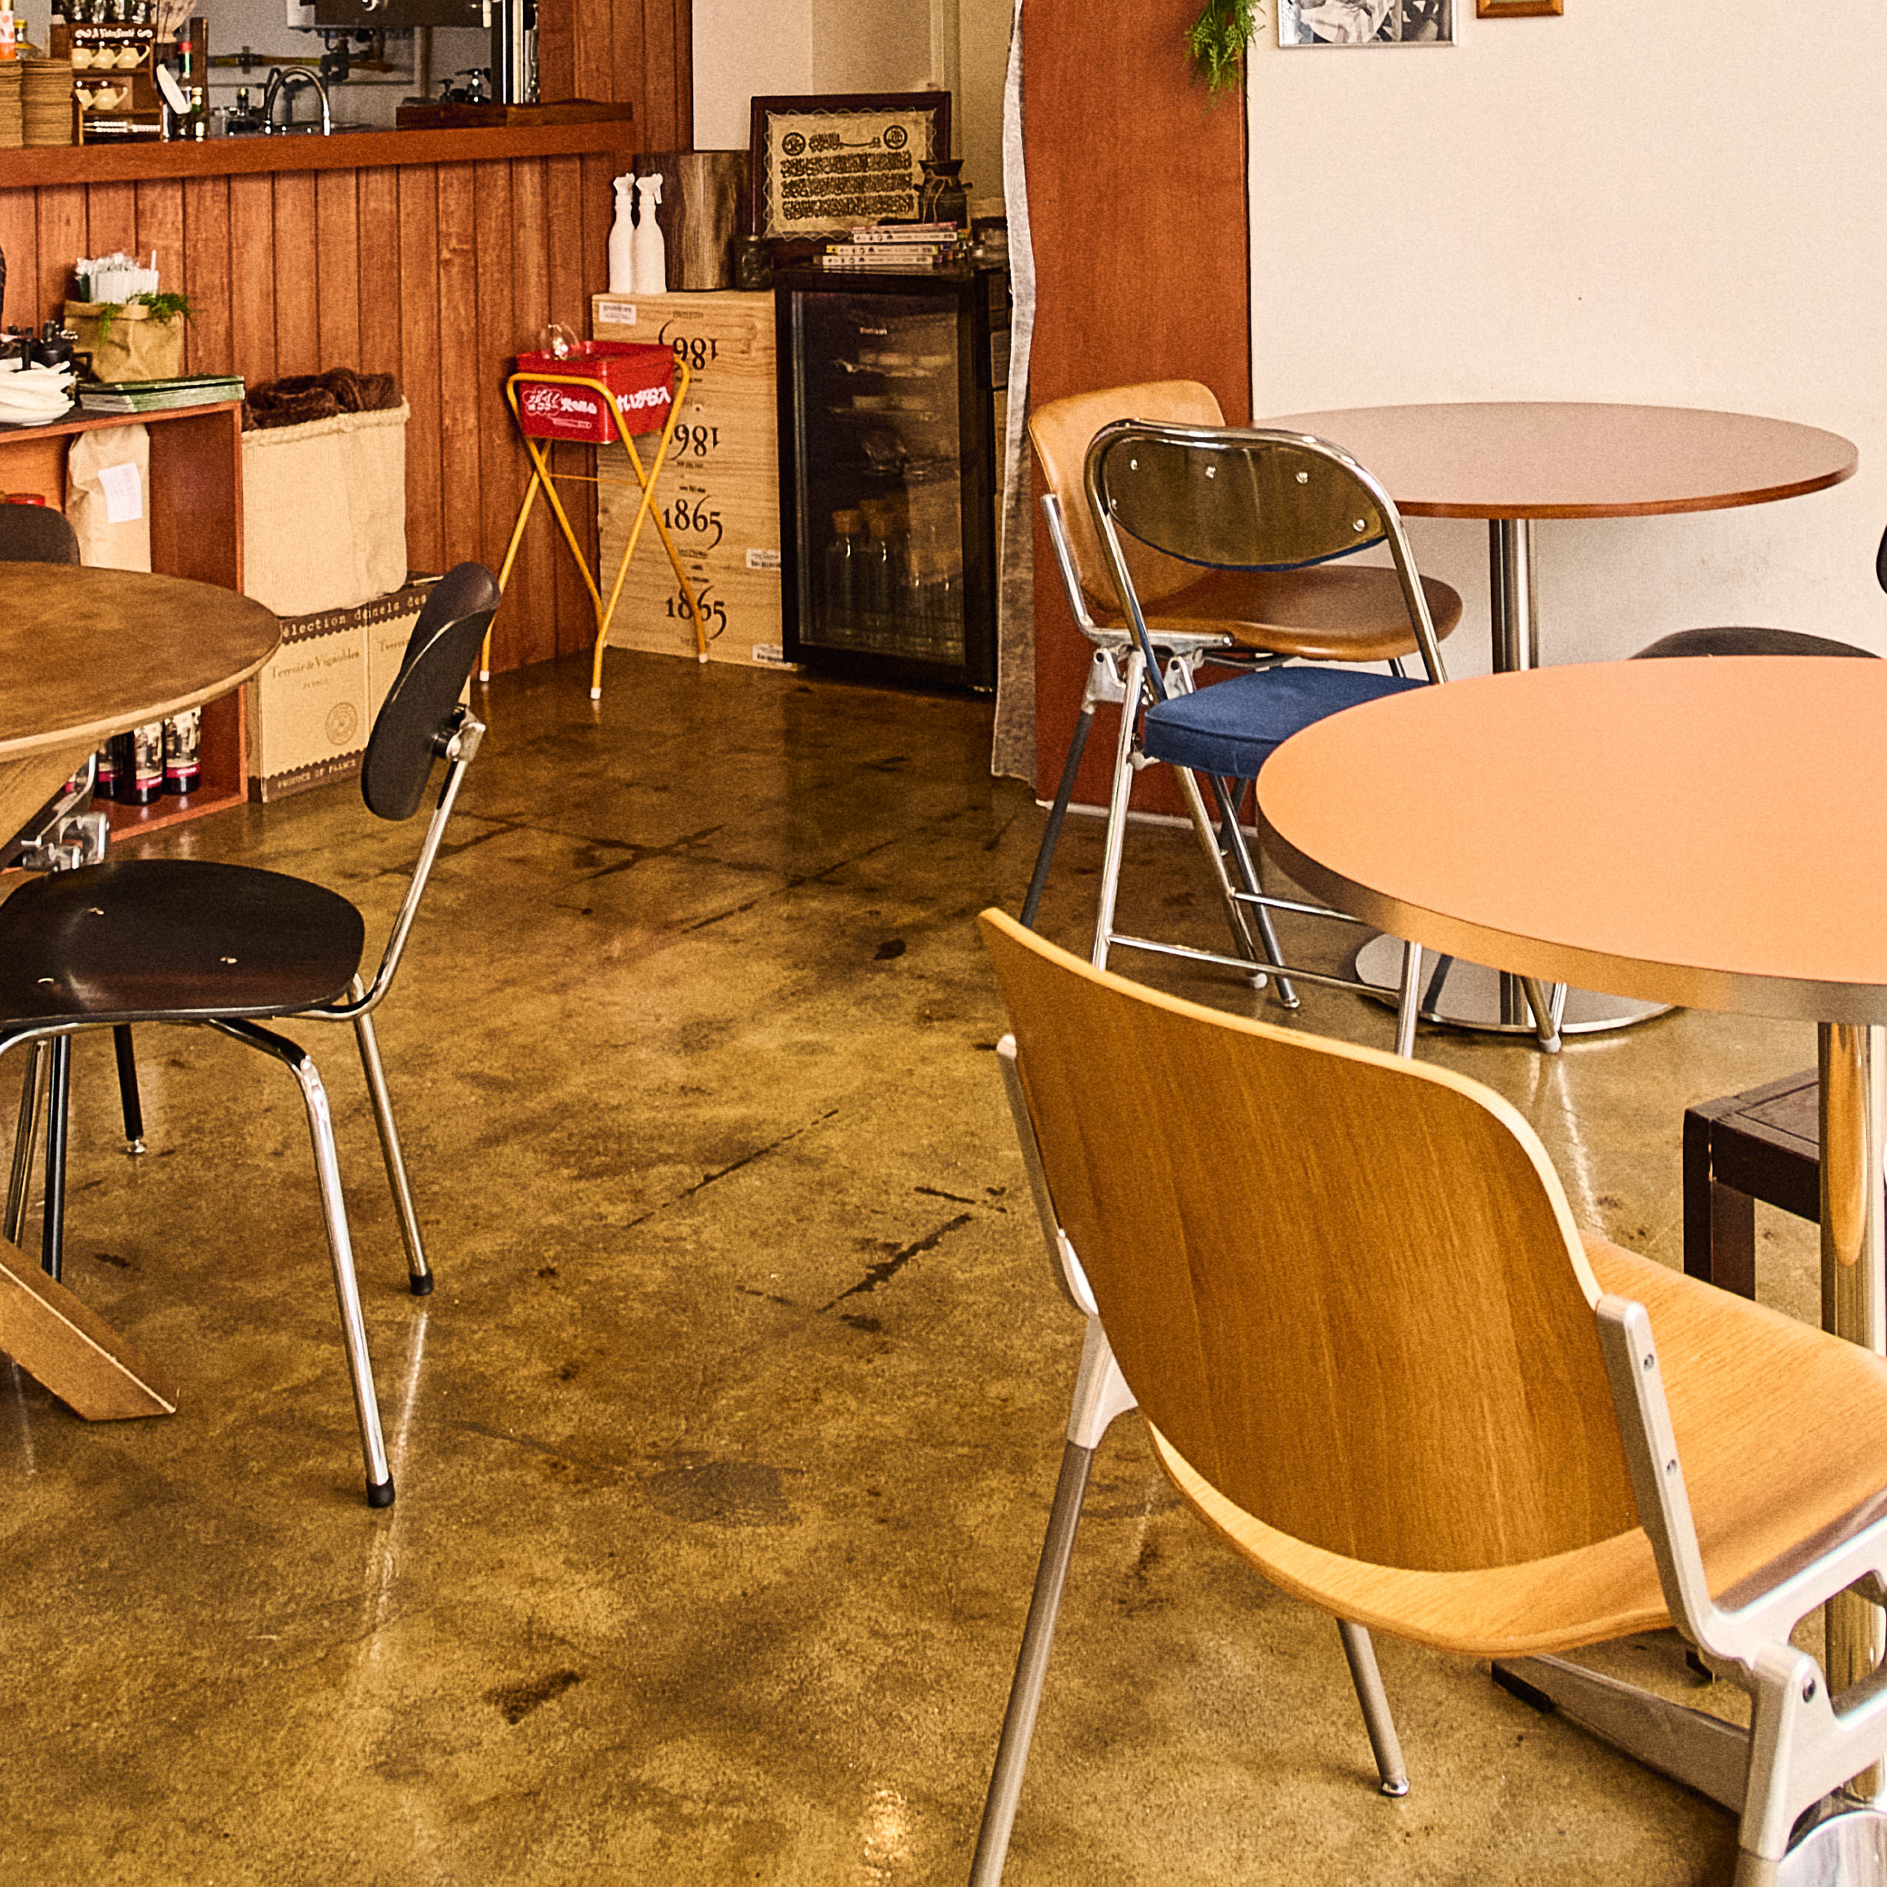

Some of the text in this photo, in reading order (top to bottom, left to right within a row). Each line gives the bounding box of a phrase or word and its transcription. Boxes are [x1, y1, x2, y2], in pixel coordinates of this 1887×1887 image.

[659, 320, 719, 371] 186
[670, 424, 719, 460] 186
[663, 495, 723, 550] 1865
[666, 586, 727, 640] 1865
